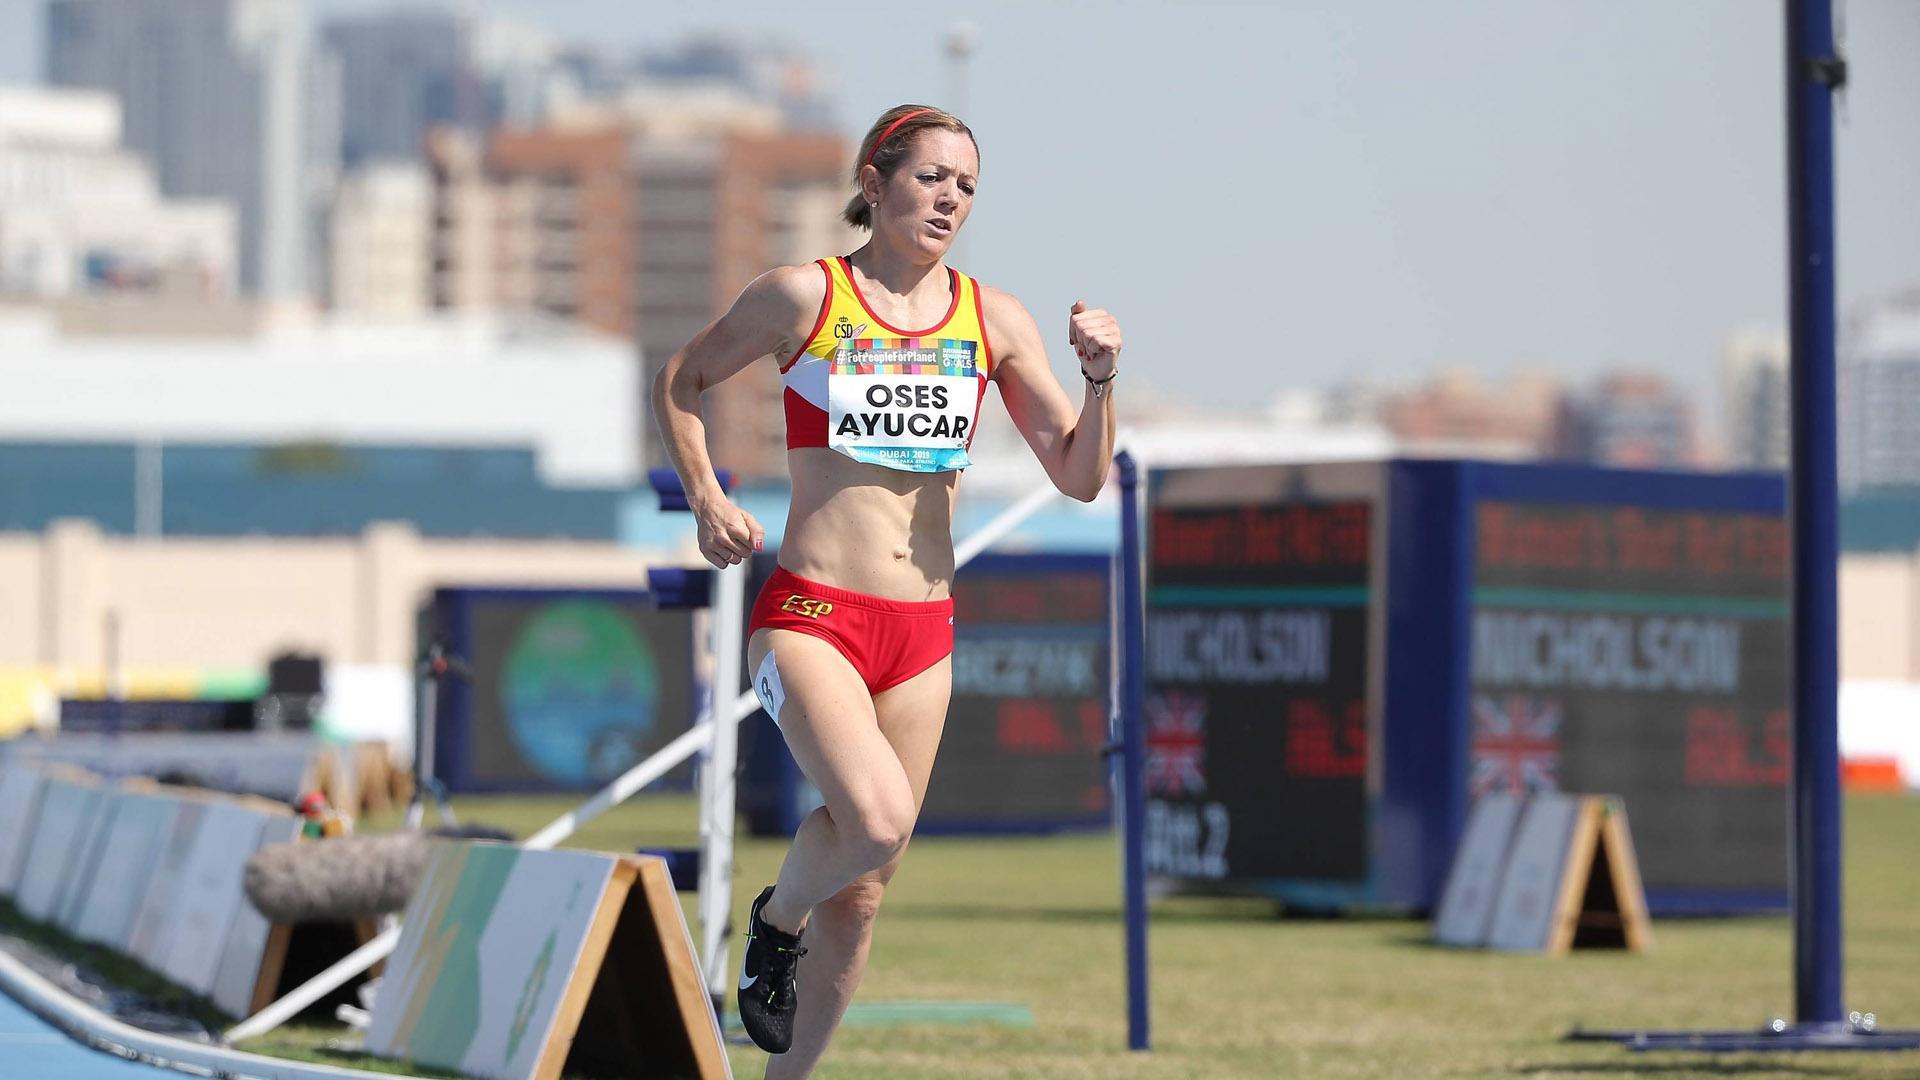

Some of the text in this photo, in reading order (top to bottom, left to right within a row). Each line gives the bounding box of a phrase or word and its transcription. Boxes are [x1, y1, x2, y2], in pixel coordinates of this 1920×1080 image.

[834, 323, 853, 339] CSD
[865, 384, 948, 409] OSES
[836, 413, 969, 439] AYUCAR
[879, 450, 930, 459] DUBAI 2019
[781, 594, 833, 619] ESP
[1147, 610, 1331, 682] NICHOLSON
[1473, 610, 1741, 692] NICHOLSON
